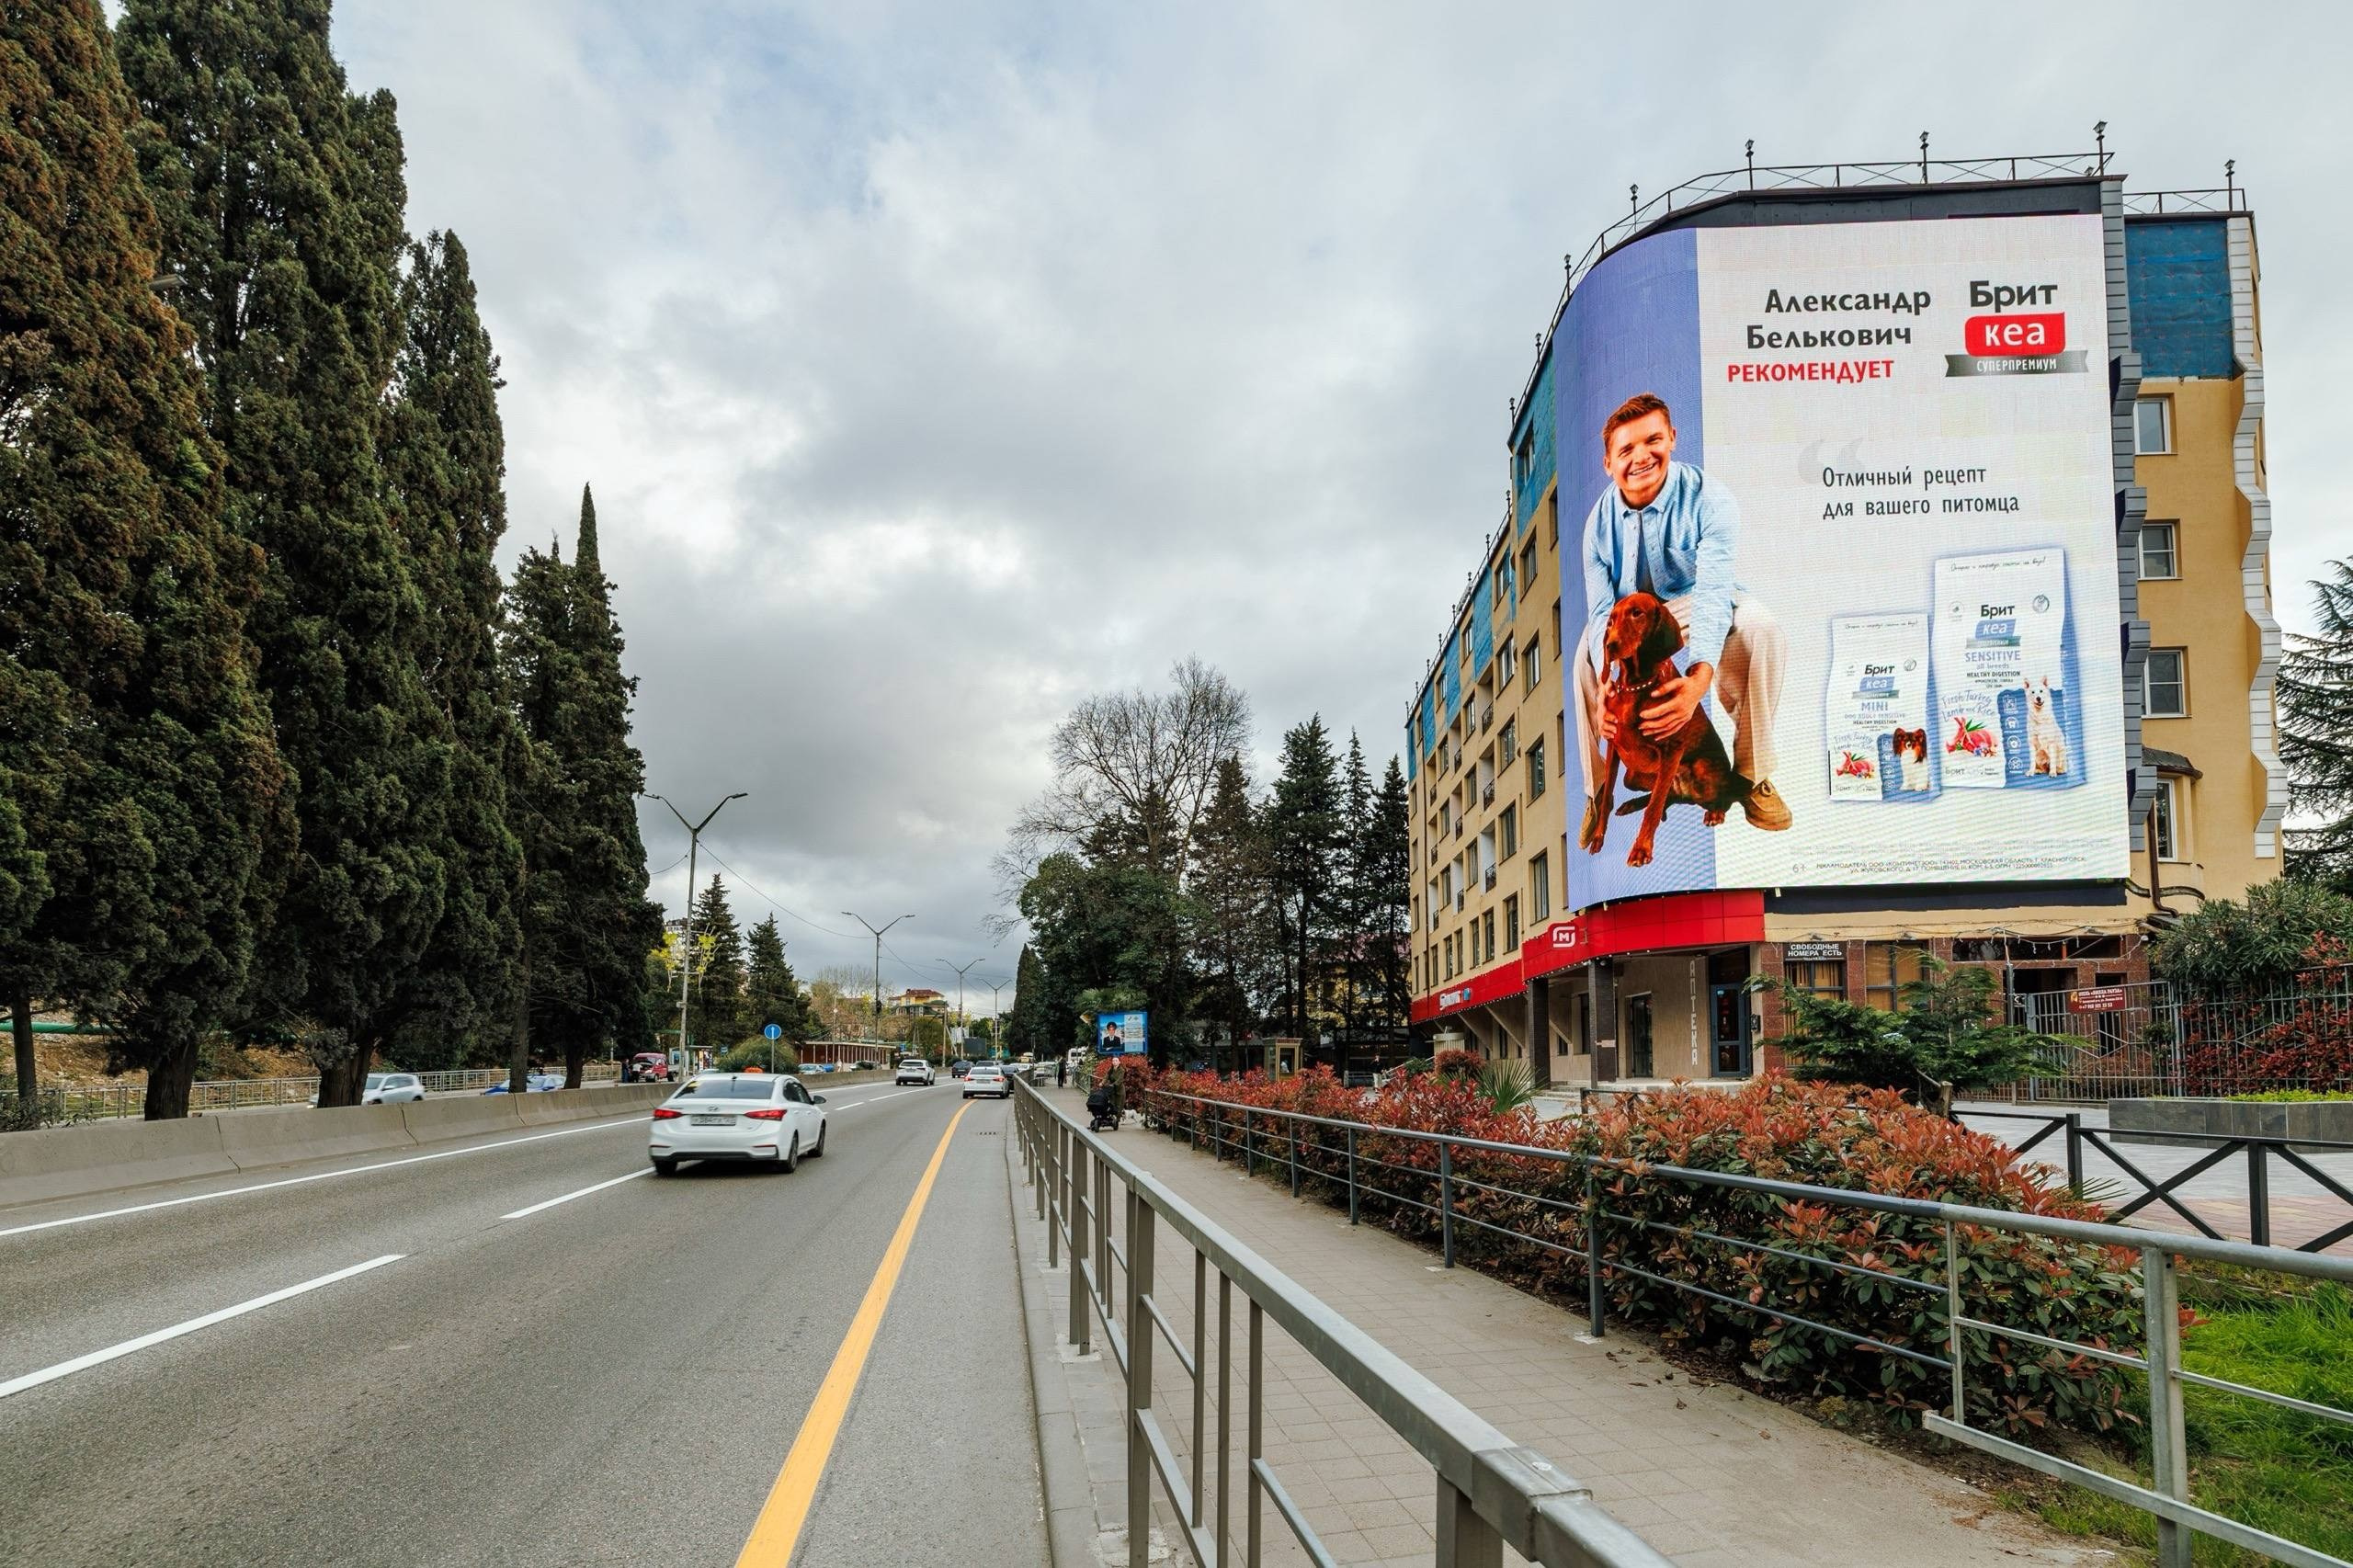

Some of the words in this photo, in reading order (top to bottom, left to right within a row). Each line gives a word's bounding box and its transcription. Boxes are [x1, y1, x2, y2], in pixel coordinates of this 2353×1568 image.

[1765, 289, 1931, 315] Александр
[1970, 280, 2058, 312] Брит
[1746, 324, 1911, 349] Белькович
[1985, 323, 2045, 347] кеа
[1727, 360, 1894, 384] РЕКОМЕНДУЕТ
[1977, 358, 2057, 372] СУПЕРПРЕМИУМ
[1823, 465, 1912, 487] Отличный
[1924, 468, 1986, 491] рецепт
[1823, 502, 1853, 520] для
[1866, 498, 1930, 516] вашего
[1942, 496, 2019, 514] питомца
[1981, 604, 2015, 619] Брит
[1983, 623, 2008, 634] кеа
[1965, 651, 2021, 662] SENSITIVE
[1864, 665, 1895, 676] Брит
[1861, 701, 1889, 710] MINI
[1792, 863, 1806, 873] 6+
[1689, 960, 1698, 1066] АПТЕКА
